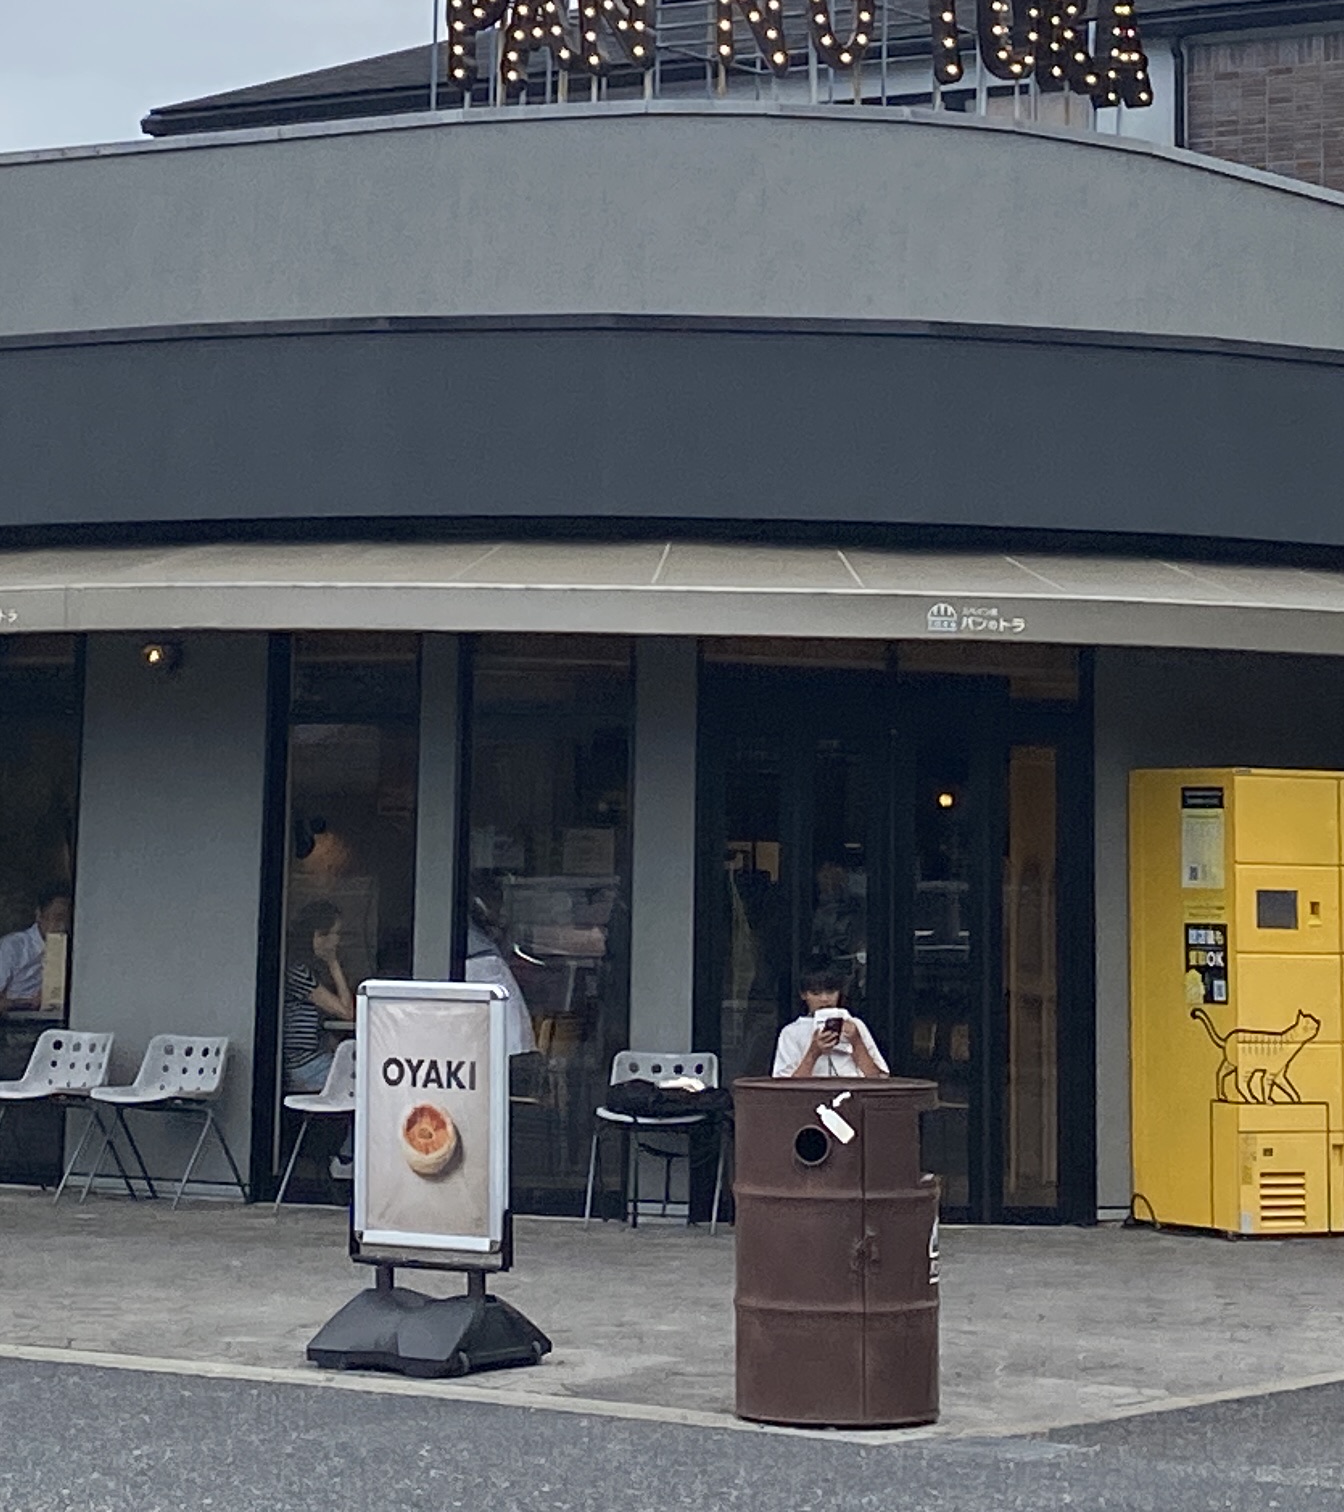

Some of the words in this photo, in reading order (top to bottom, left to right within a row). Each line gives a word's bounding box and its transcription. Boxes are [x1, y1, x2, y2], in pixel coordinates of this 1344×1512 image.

[960, 616, 1025, 633] パンのトラ
[382, 1057, 476, 1090] OYAKI
